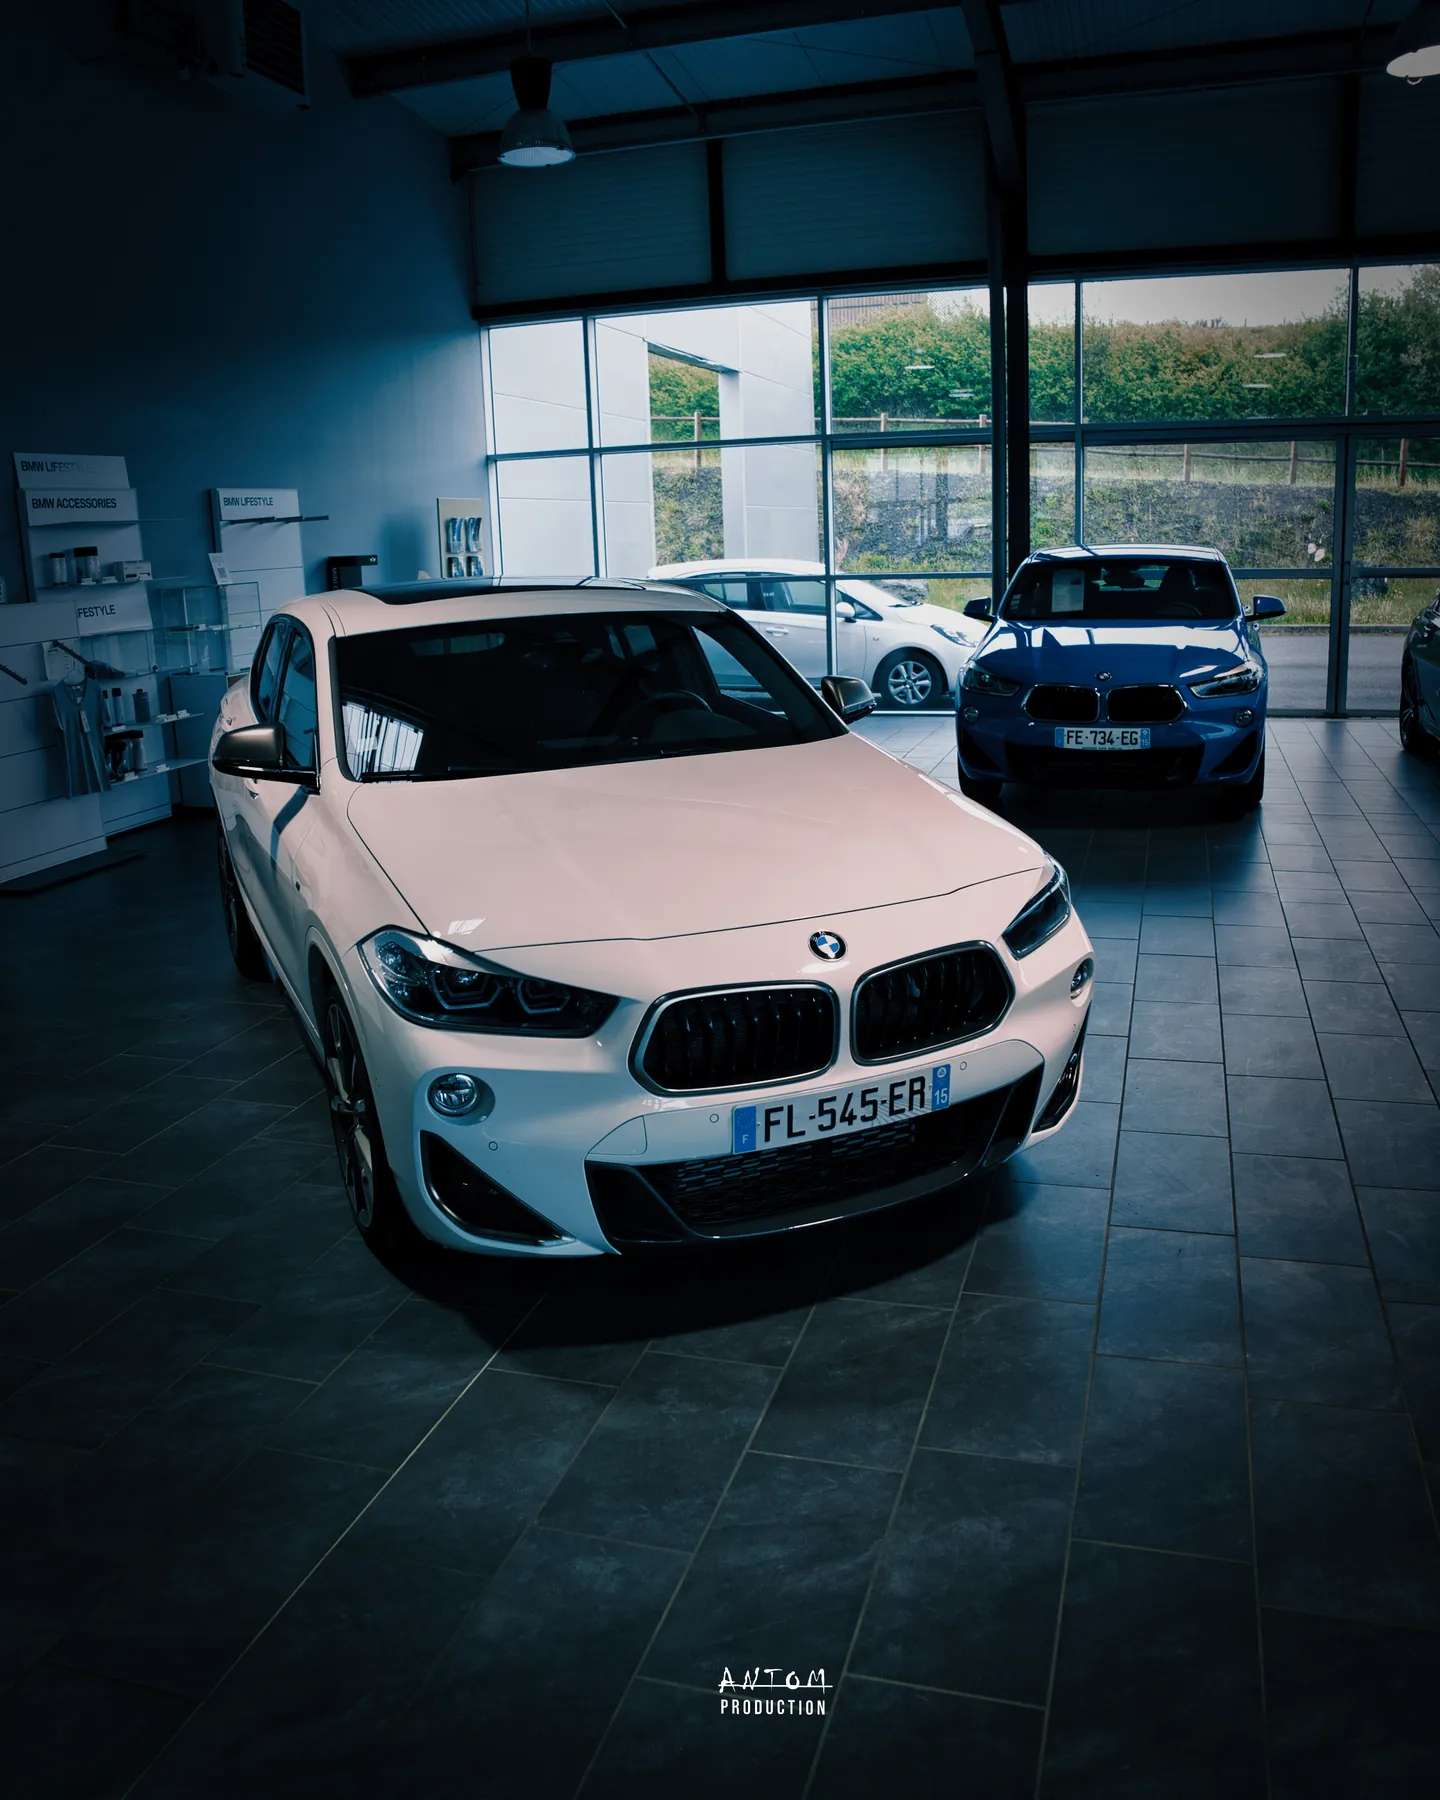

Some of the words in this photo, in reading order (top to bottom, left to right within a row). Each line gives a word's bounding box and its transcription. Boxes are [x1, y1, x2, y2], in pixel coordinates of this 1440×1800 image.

[21, 460, 44, 472] BMW
[32, 498, 55, 509] BMW
[56, 498, 117, 509] ACCESSORIES
[223, 497, 240, 507] BMW
[240, 497, 274, 507] LIFESTYLE
[76, 604, 116, 618] FESTYLE
[1067, 730, 1138, 745] FE-734-EG
[934, 1087, 949, 1106] 15
[764, 1075, 927, 1143] FL-545-ER
[742, 1133, 749, 1145] F
